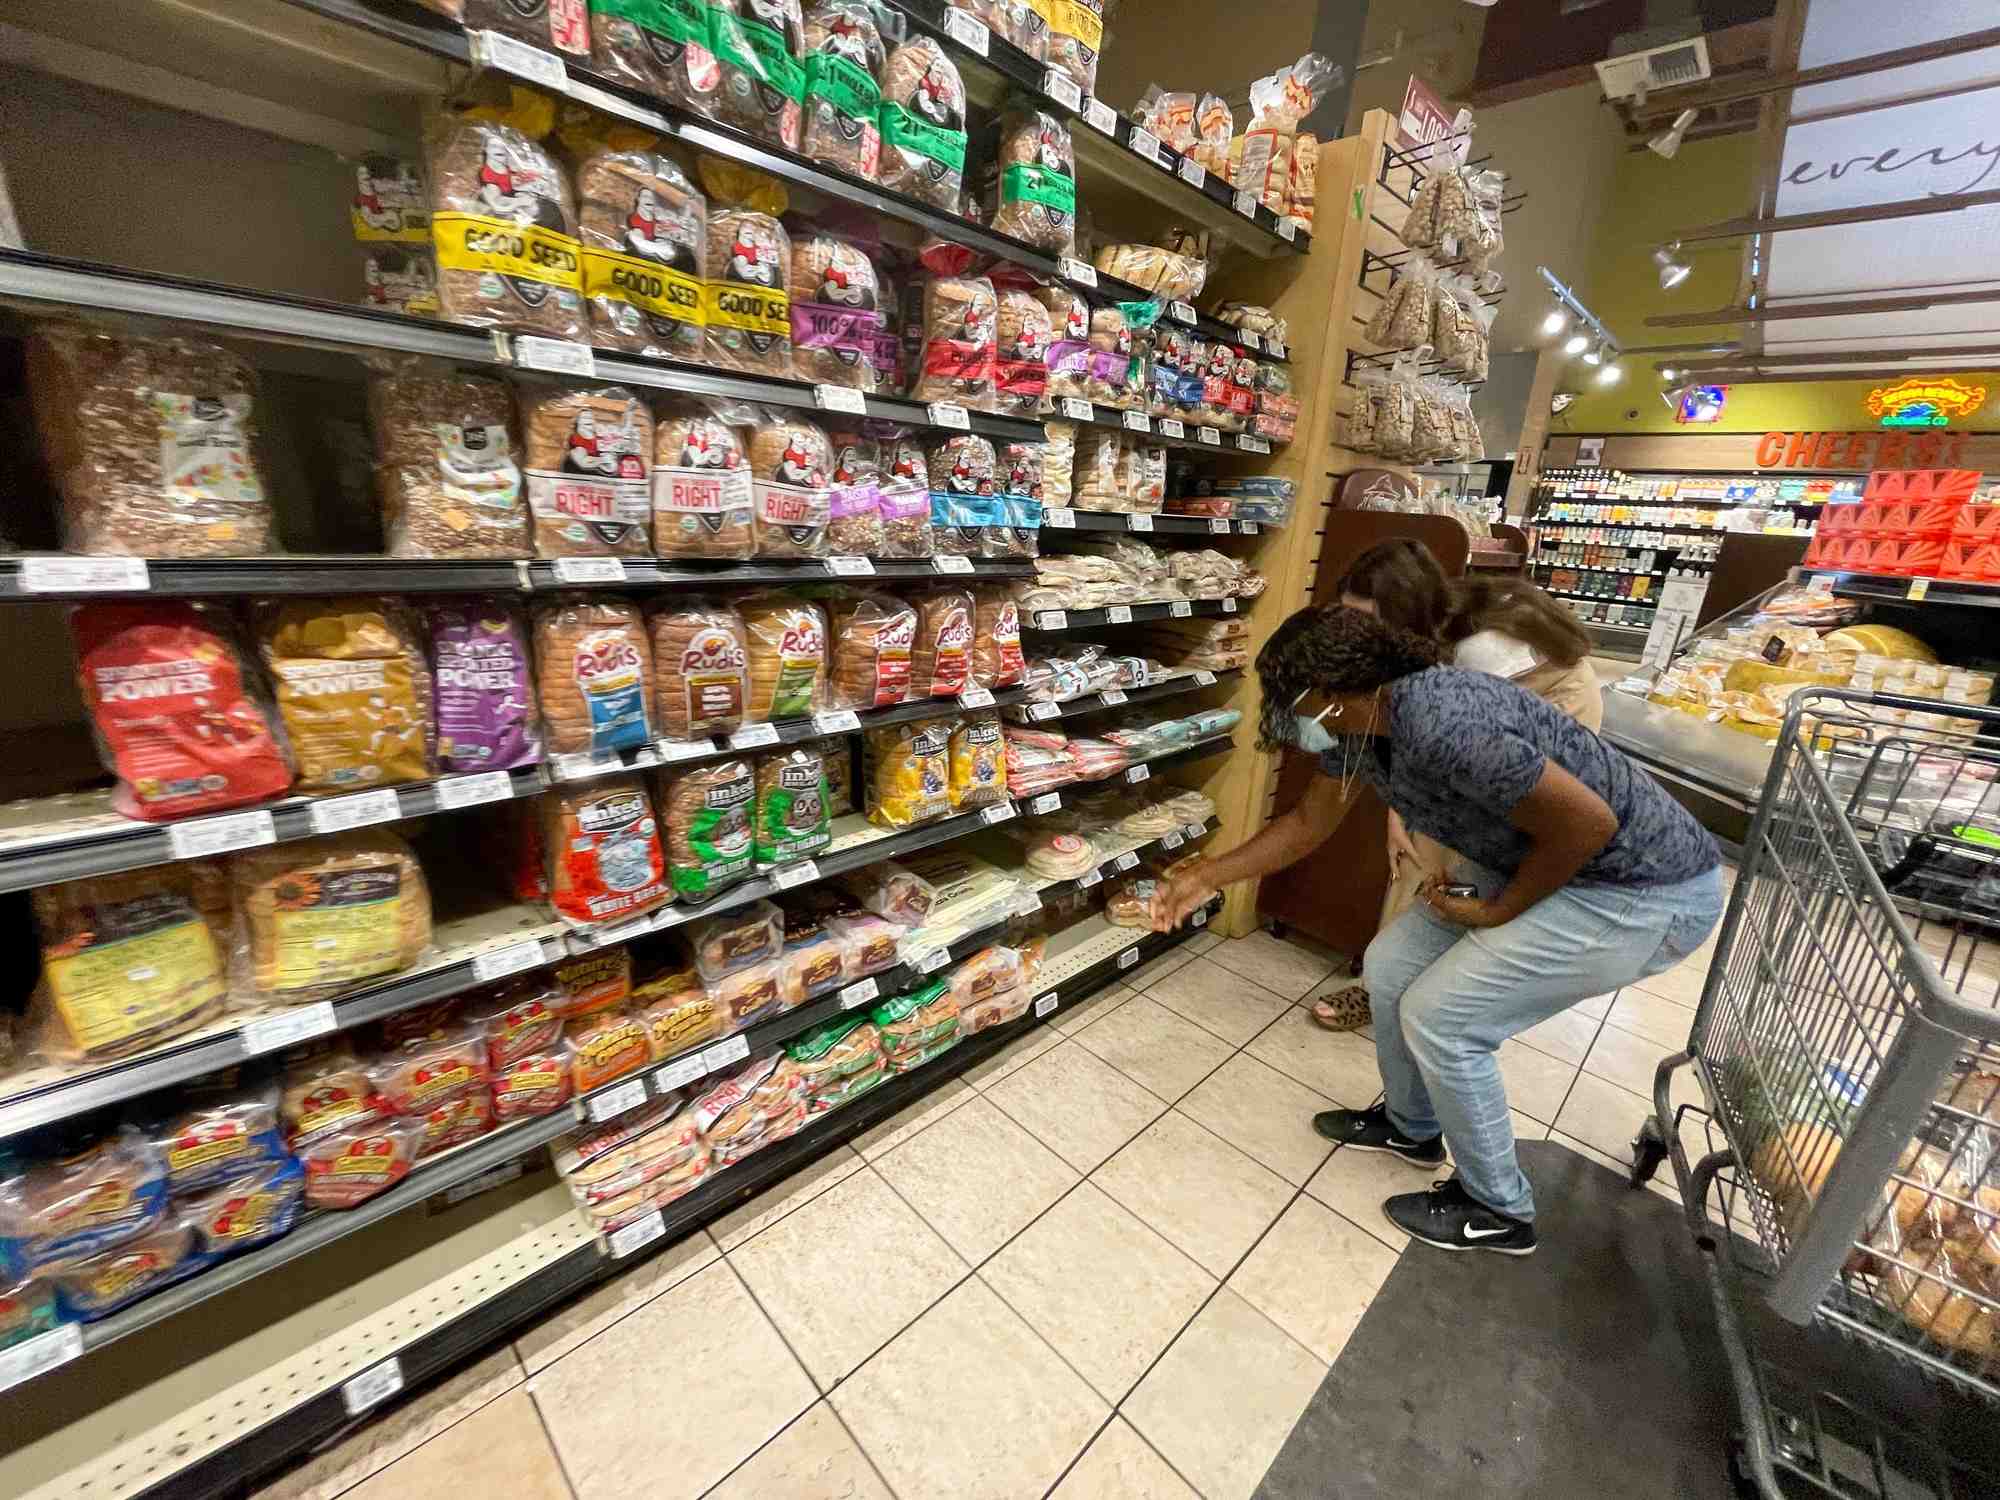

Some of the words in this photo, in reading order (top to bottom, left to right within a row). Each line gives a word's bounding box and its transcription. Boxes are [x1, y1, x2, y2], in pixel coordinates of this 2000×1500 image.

[464, 228, 524, 258] GOOD
[530, 240, 577, 272] SEED
[611, 267, 662, 298] GOOD
[718, 291, 763, 317] GOOD
[808, 312, 857, 338] 100%
[555, 490, 616, 517] RIGHT
[671, 484, 721, 508] RIGHT
[766, 498, 808, 520] RIGHT
[437, 669, 516, 690] POWER
